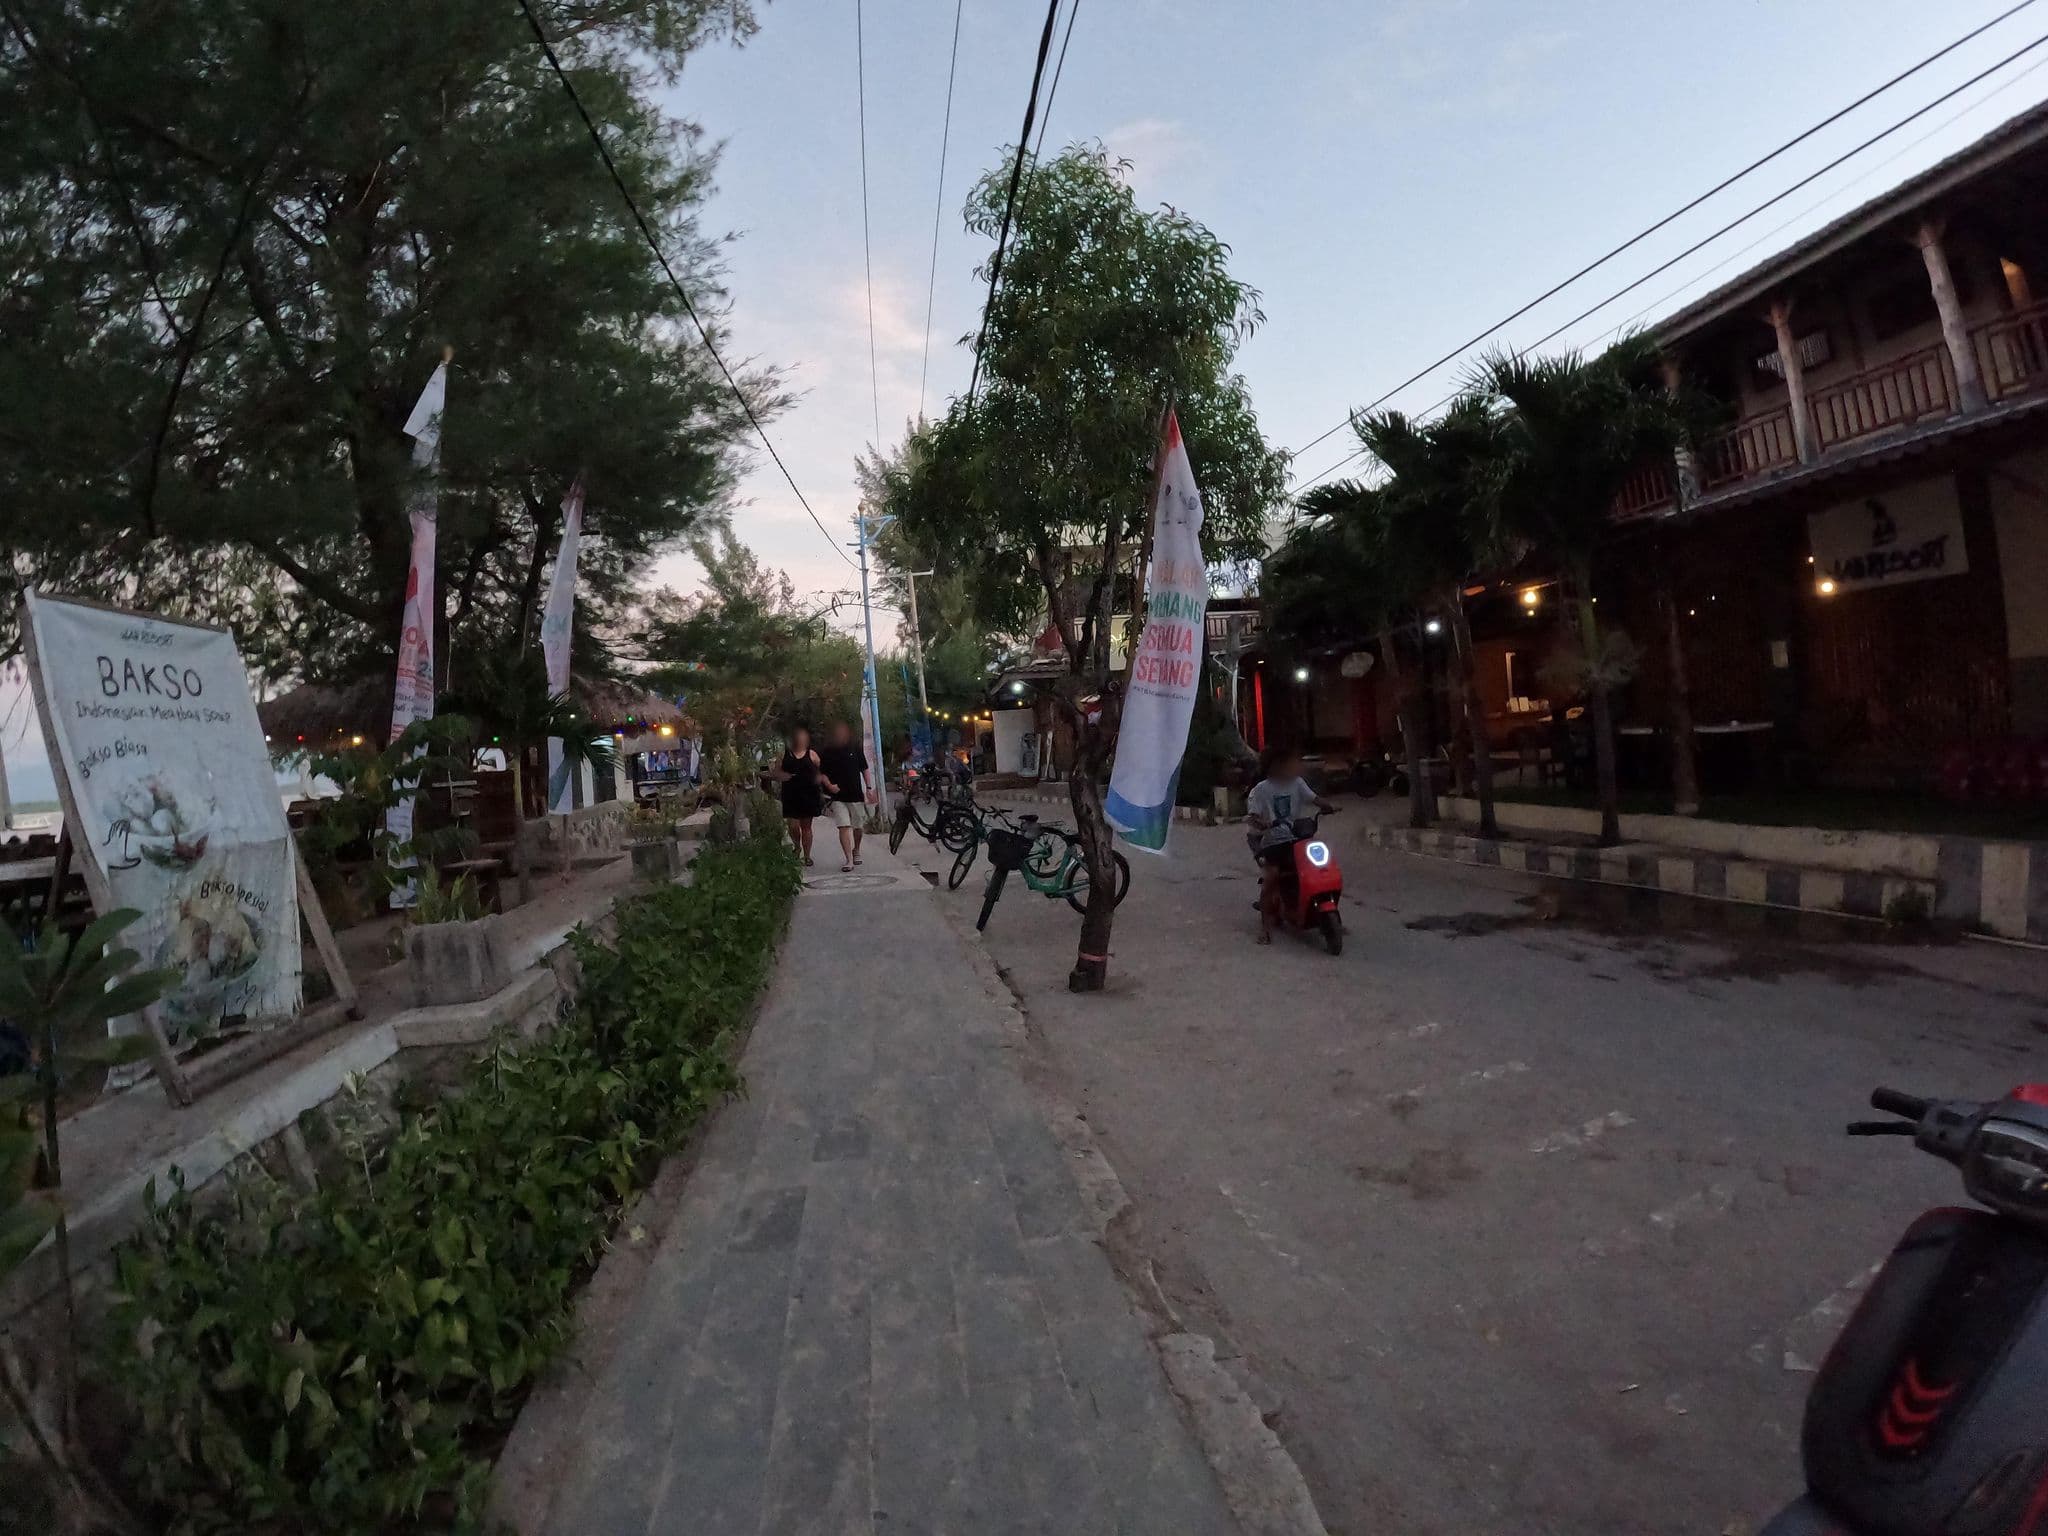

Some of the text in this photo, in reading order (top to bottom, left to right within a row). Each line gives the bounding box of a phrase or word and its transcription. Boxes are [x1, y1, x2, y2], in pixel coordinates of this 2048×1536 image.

[97, 656, 203, 701] BAKSO
[76, 700, 147, 721] Indonesian
[79, 736, 148, 779] Bakso Biasa
